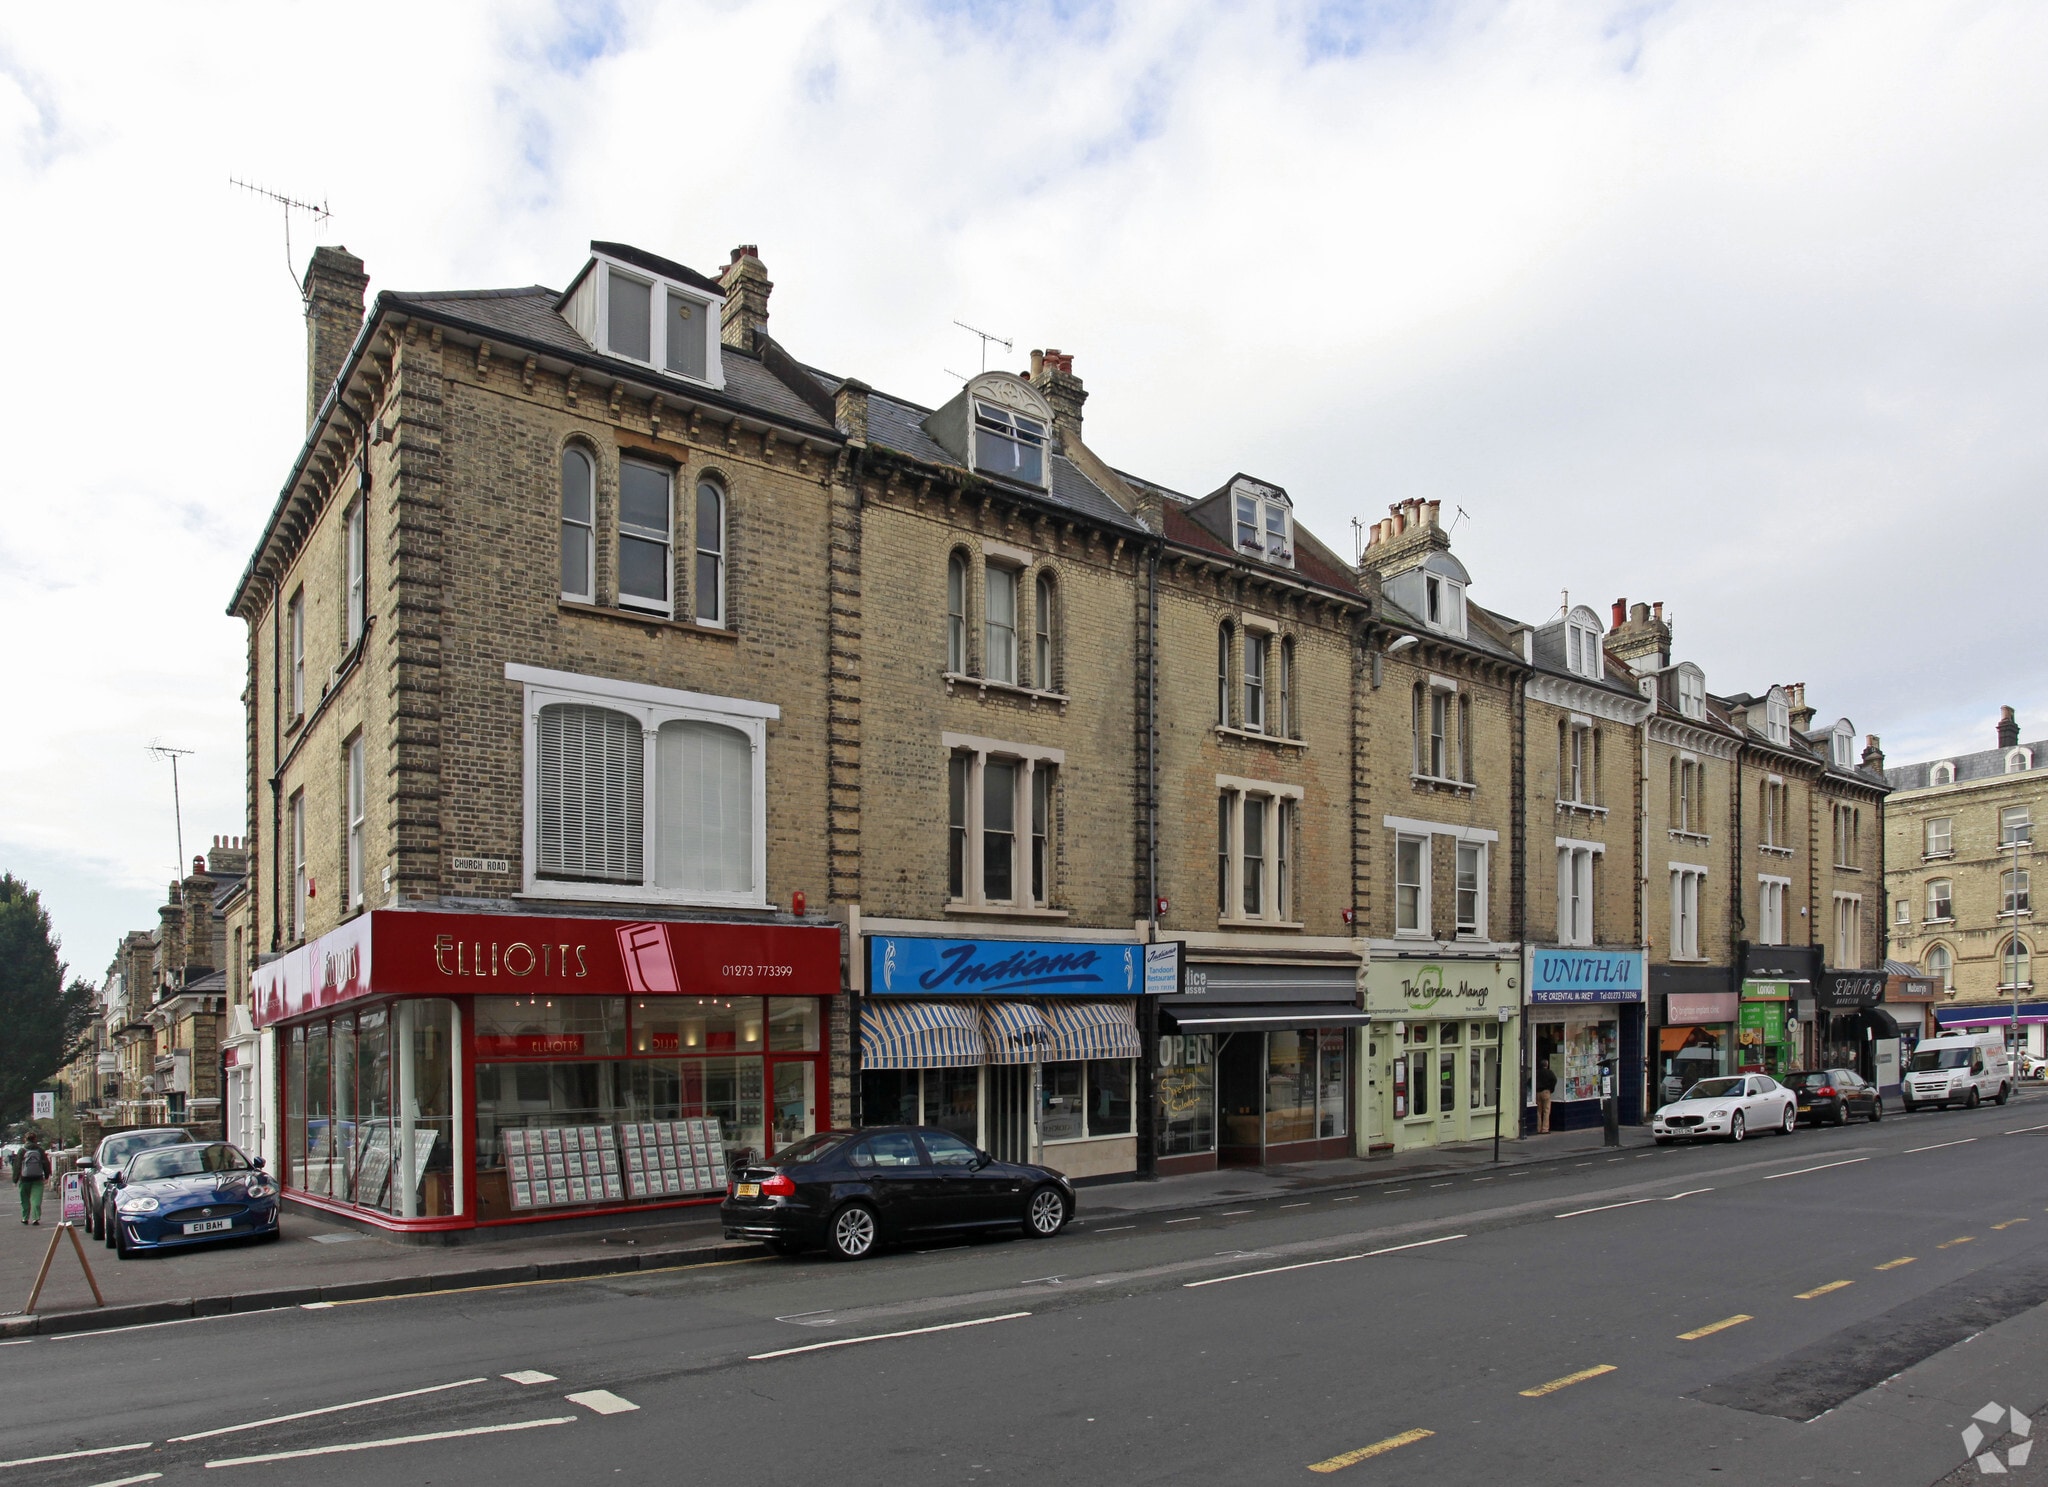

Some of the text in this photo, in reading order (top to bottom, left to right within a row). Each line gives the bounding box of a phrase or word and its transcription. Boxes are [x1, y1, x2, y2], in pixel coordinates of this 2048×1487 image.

[454, 859, 507, 871] CHURCH ROAD
[434, 934, 588, 977] ELLIOTTS
[1147, 947, 1176, 963] Indiana
[722, 965, 793, 977] 01273 773399
[919, 943, 1102, 990] Indiana
[1149, 966, 1174, 974] Tandoori
[1543, 958, 1631, 983] UNITHAI
[1147, 974, 1176, 982] Restaurant
[1185, 965, 1206, 986] lice
[1402, 979, 1489, 1006] The Green Mango
[1757, 984, 1776, 995] Londis
[1537, 992, 1548, 1001] THE
[1548, 991, 1573, 1001] ORIENTAL
[532, 1041, 578, 1051] ELLIOTTS
[1160, 1035, 1213, 1067] OPEN
[206, 1221, 223, 1230] BAH
